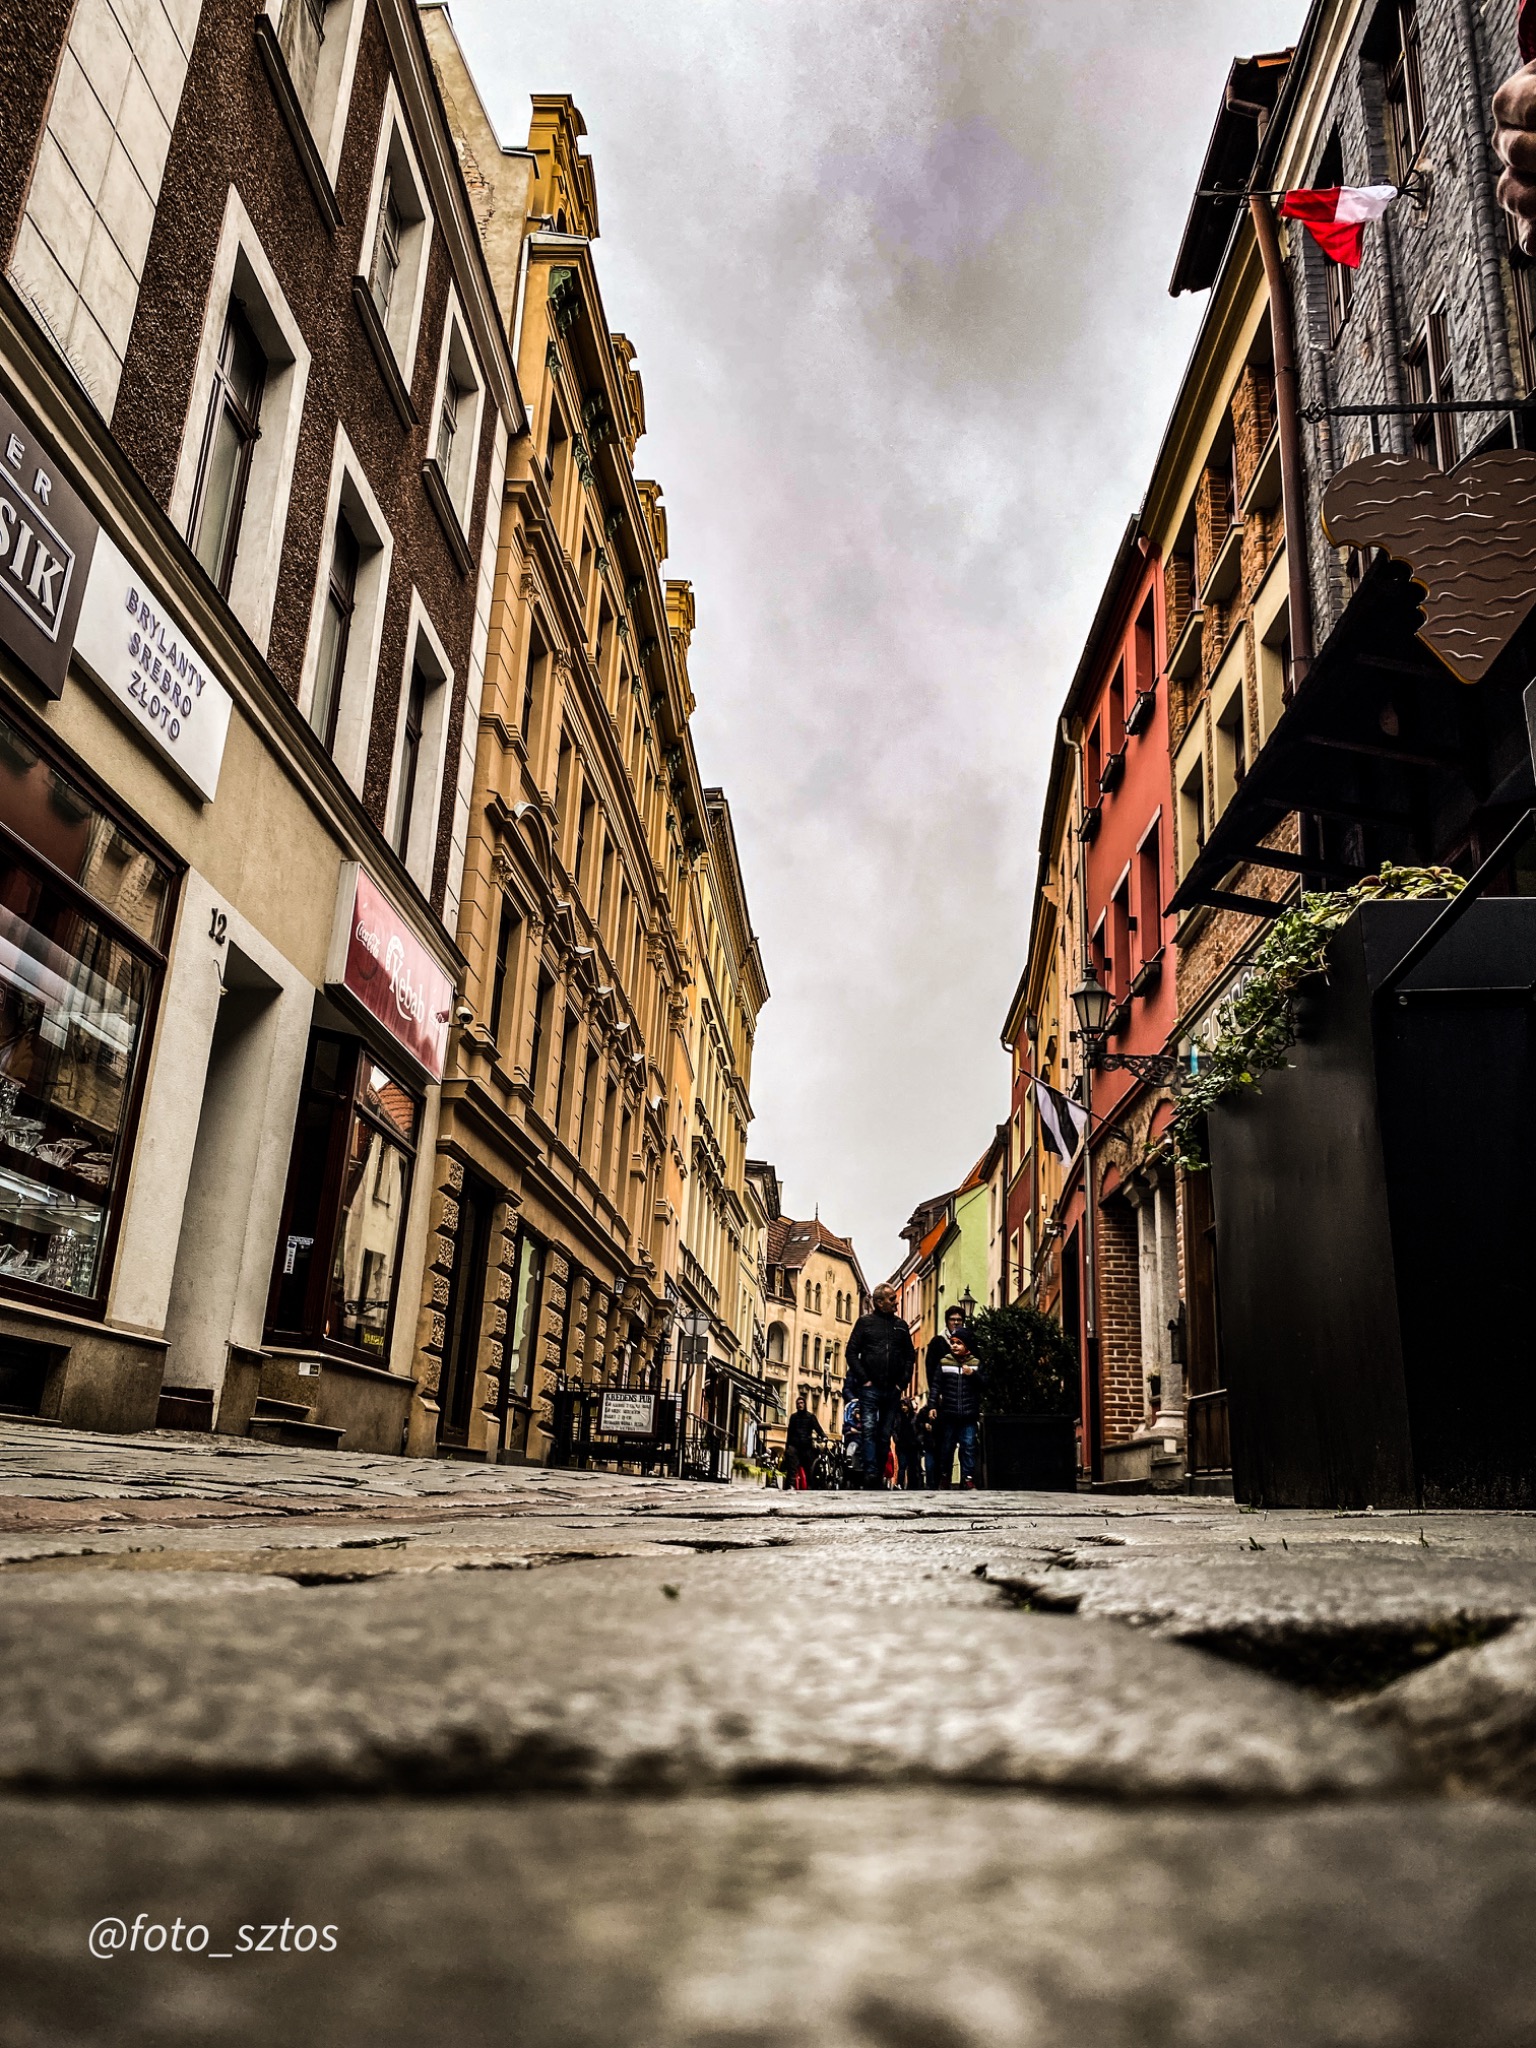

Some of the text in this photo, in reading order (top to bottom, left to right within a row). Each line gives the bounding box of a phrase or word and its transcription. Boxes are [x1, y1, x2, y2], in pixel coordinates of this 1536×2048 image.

[125, 586, 207, 698] BRYLANTY
[128, 631, 193, 718] SREBRO
[127, 670, 181, 742] ZŁOTO
[208, 907, 227, 947] 12
[388, 952, 426, 1023] Kebab
[605, 1393, 652, 1404] KREDENS PUB
